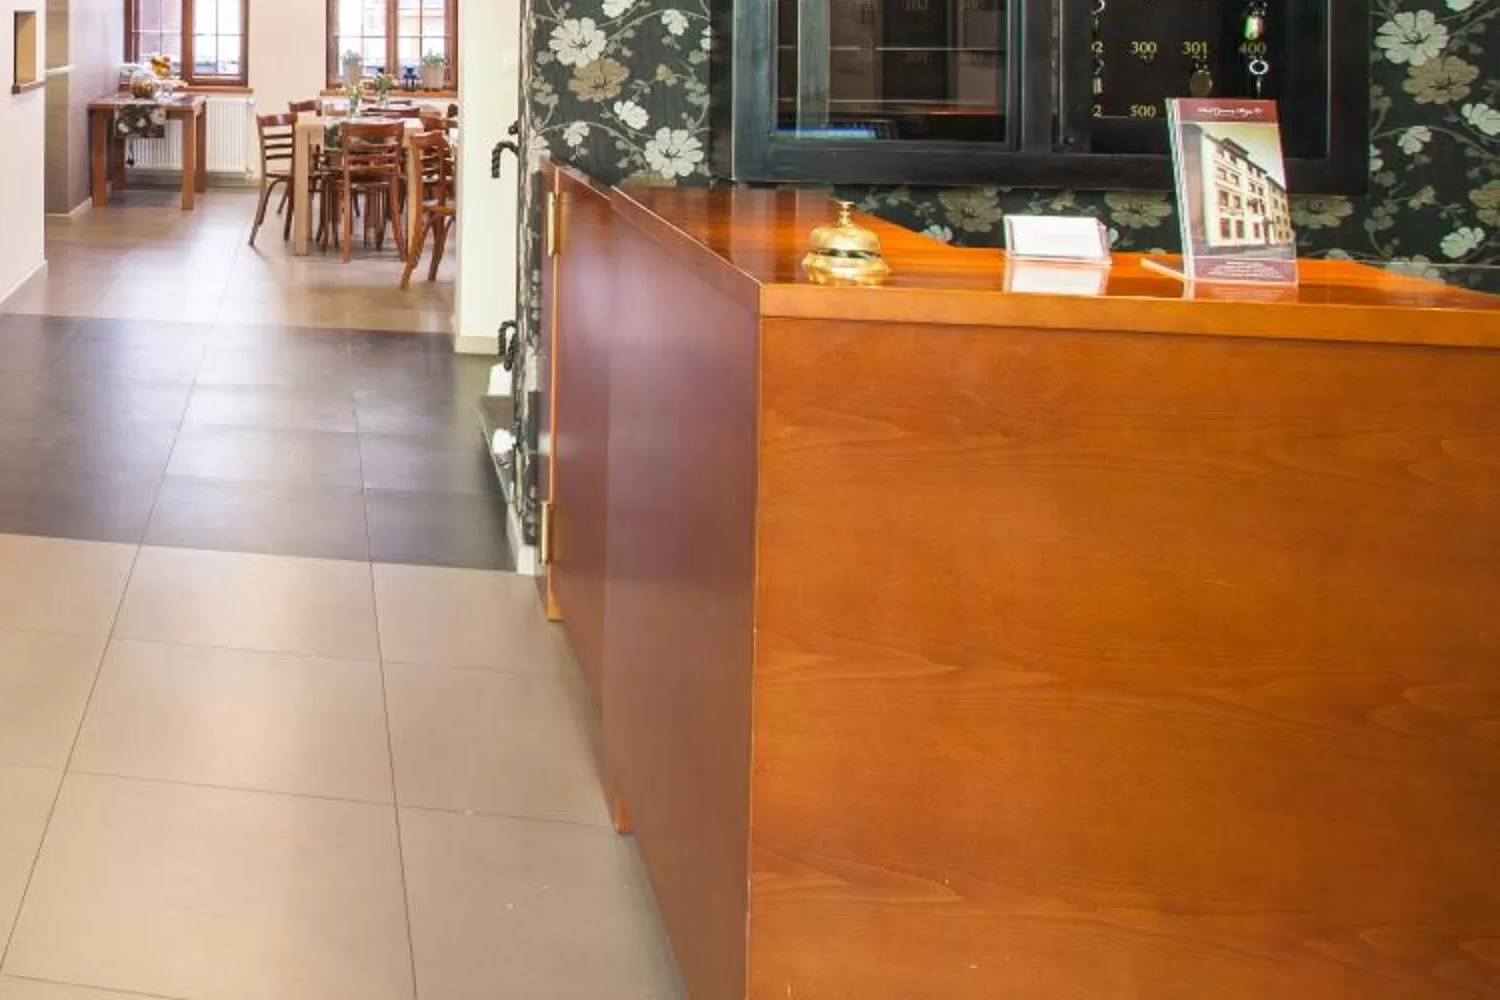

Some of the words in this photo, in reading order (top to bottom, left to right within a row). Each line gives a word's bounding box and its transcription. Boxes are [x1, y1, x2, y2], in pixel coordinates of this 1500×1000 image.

[1131, 41, 1158, 56] 300
[1183, 41, 1208, 55] 301
[1238, 41, 1267, 56] 400
[1129, 104, 1157, 118] 500
